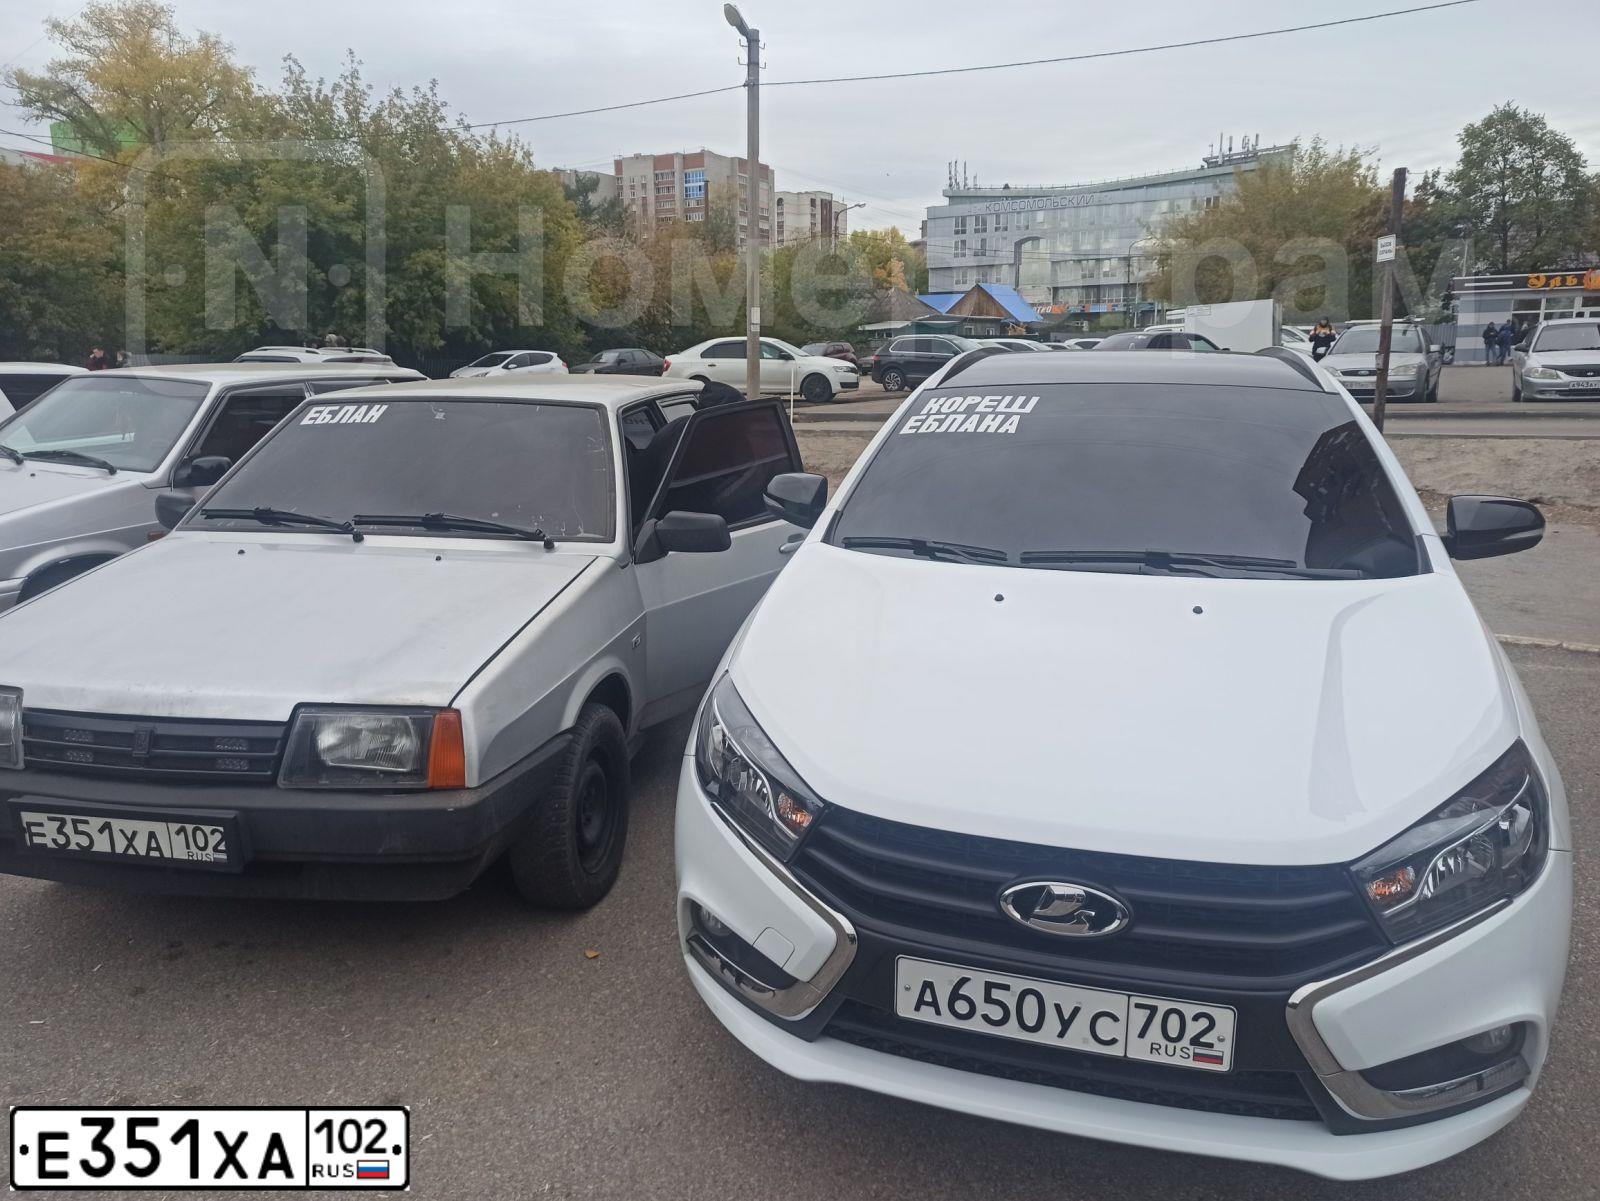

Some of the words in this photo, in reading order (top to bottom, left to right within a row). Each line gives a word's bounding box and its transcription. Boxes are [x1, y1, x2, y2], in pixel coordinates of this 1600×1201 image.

[300, 405, 389, 425] ЕБЛАН
[920, 396, 1040, 415] КОРЕШ
[899, 414, 1021, 434] ЕБЛАНА
[26, 815, 165, 858] Е351ХА
[175, 825, 226, 854] 102
[187, 851, 214, 862] RUS
[914, 976, 1121, 1046] А650УС
[1134, 1002, 1217, 1049] 702
[1150, 1042, 1191, 1060] RUS
